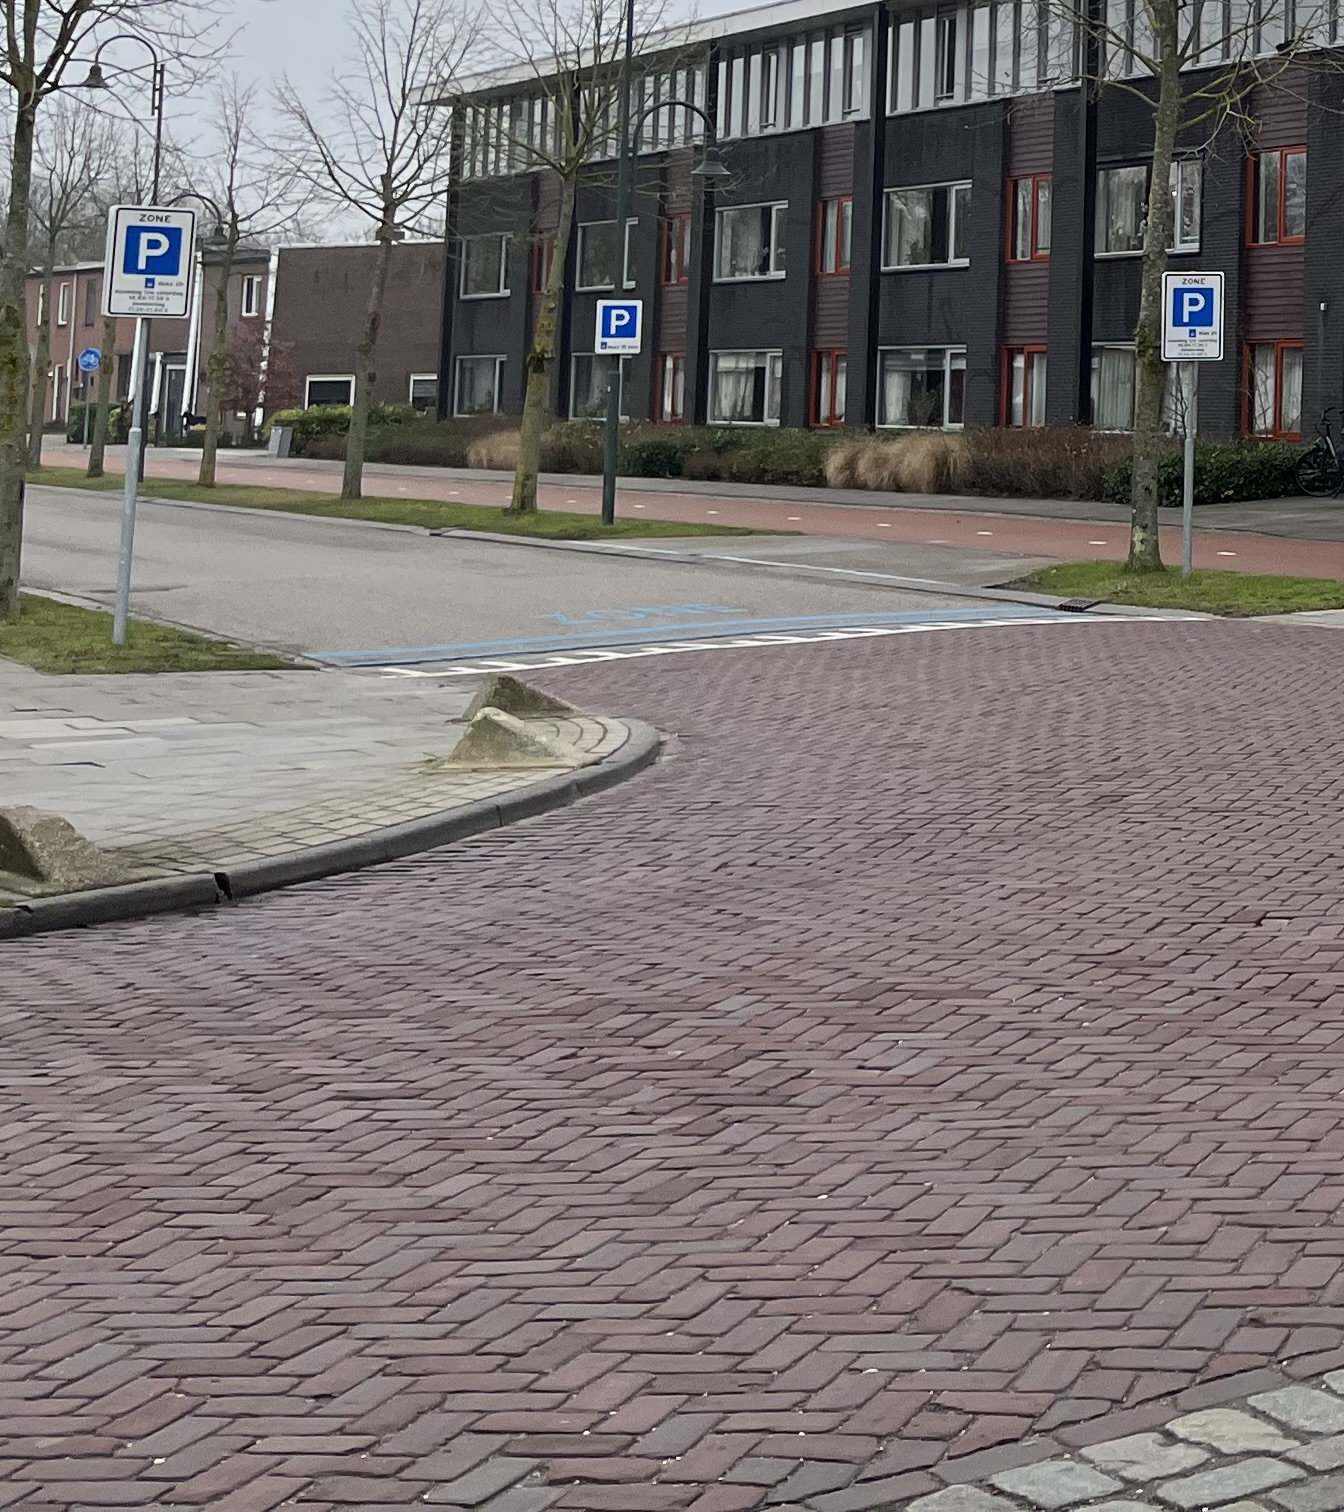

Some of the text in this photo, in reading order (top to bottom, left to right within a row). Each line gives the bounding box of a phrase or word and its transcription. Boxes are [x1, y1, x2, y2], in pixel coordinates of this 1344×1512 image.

[139, 214, 172, 223] ZONE
[137, 231, 170, 271] P
[610, 308, 631, 335] P
[1182, 292, 1206, 323] P
